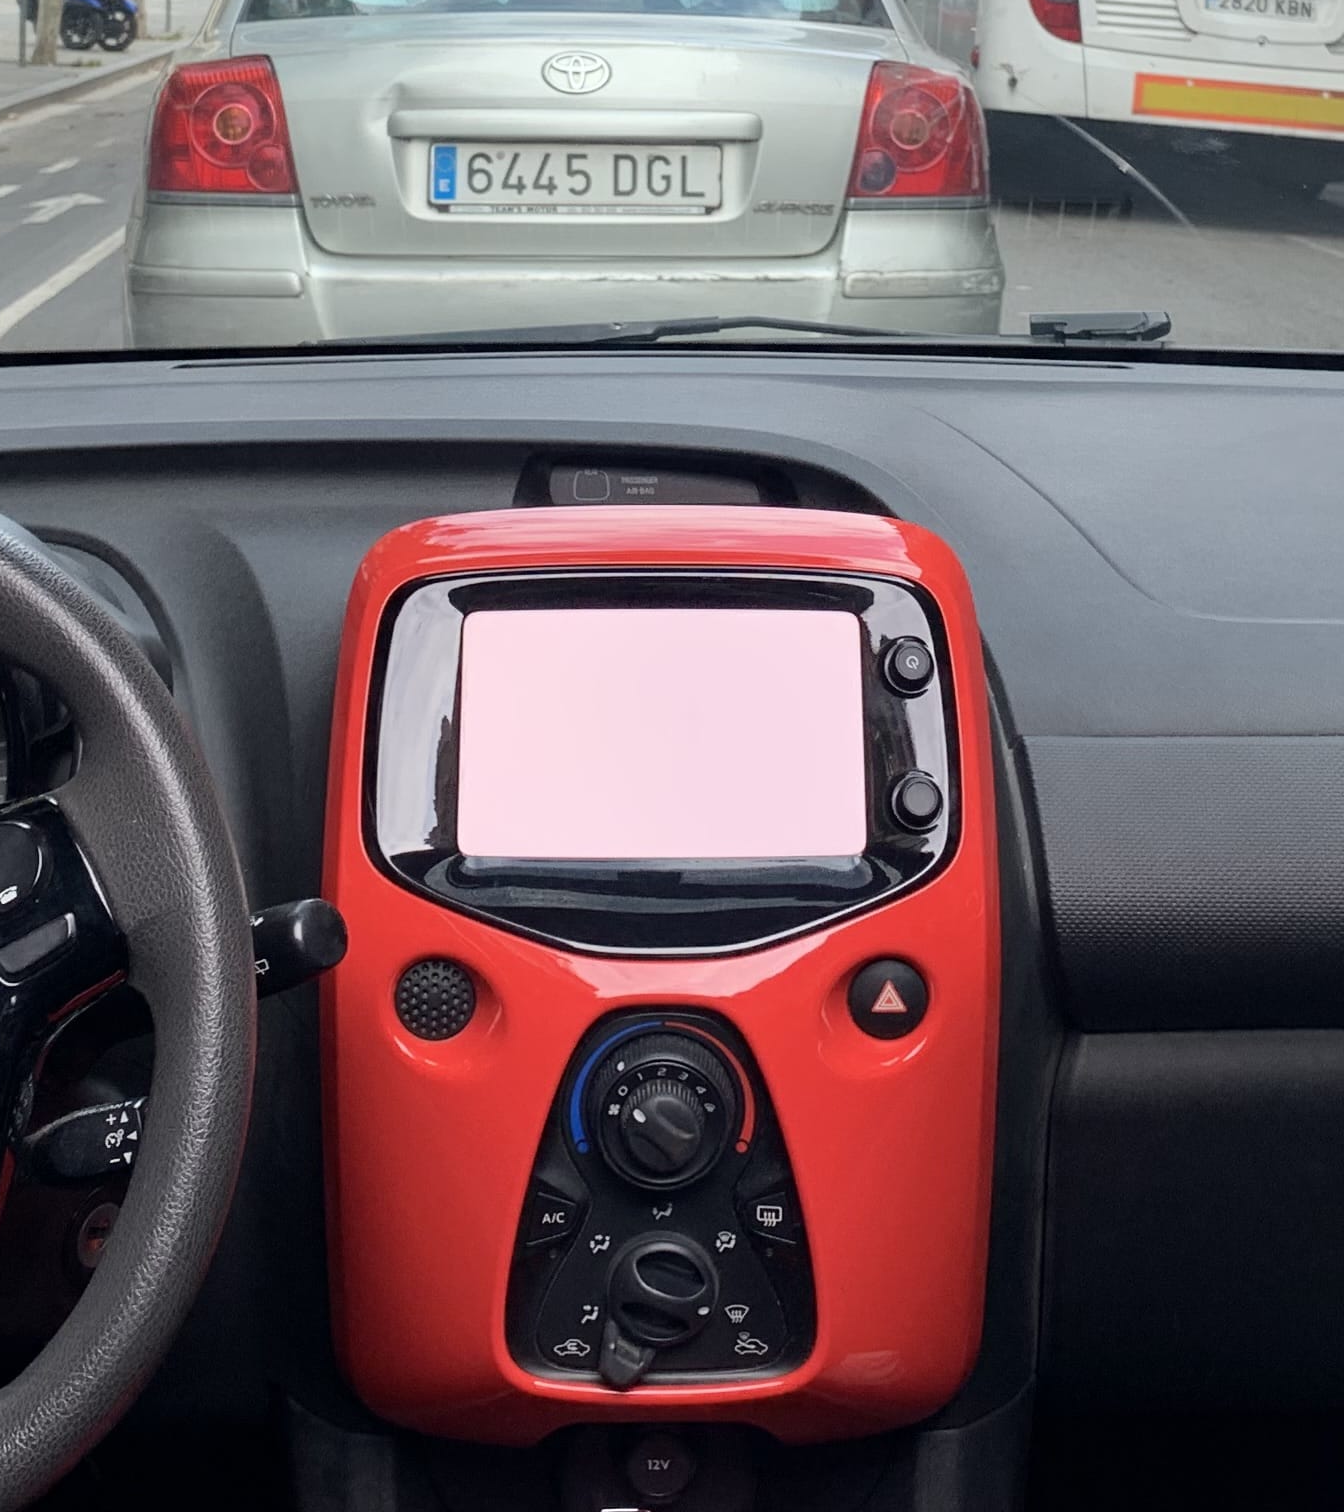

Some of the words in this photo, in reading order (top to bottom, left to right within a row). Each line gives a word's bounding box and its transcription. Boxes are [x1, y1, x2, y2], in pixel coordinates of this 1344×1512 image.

[466, 151, 592, 196] 6445
[612, 153, 705, 197] DGL
[439, 178, 451, 192] E
[657, 1068, 667, 1077] 2
[678, 1071, 689, 1081] 3
[696, 1085, 707, 1094] 4
[542, 1212, 565, 1224] A/C
[647, 1459, 671, 1471] 12V
